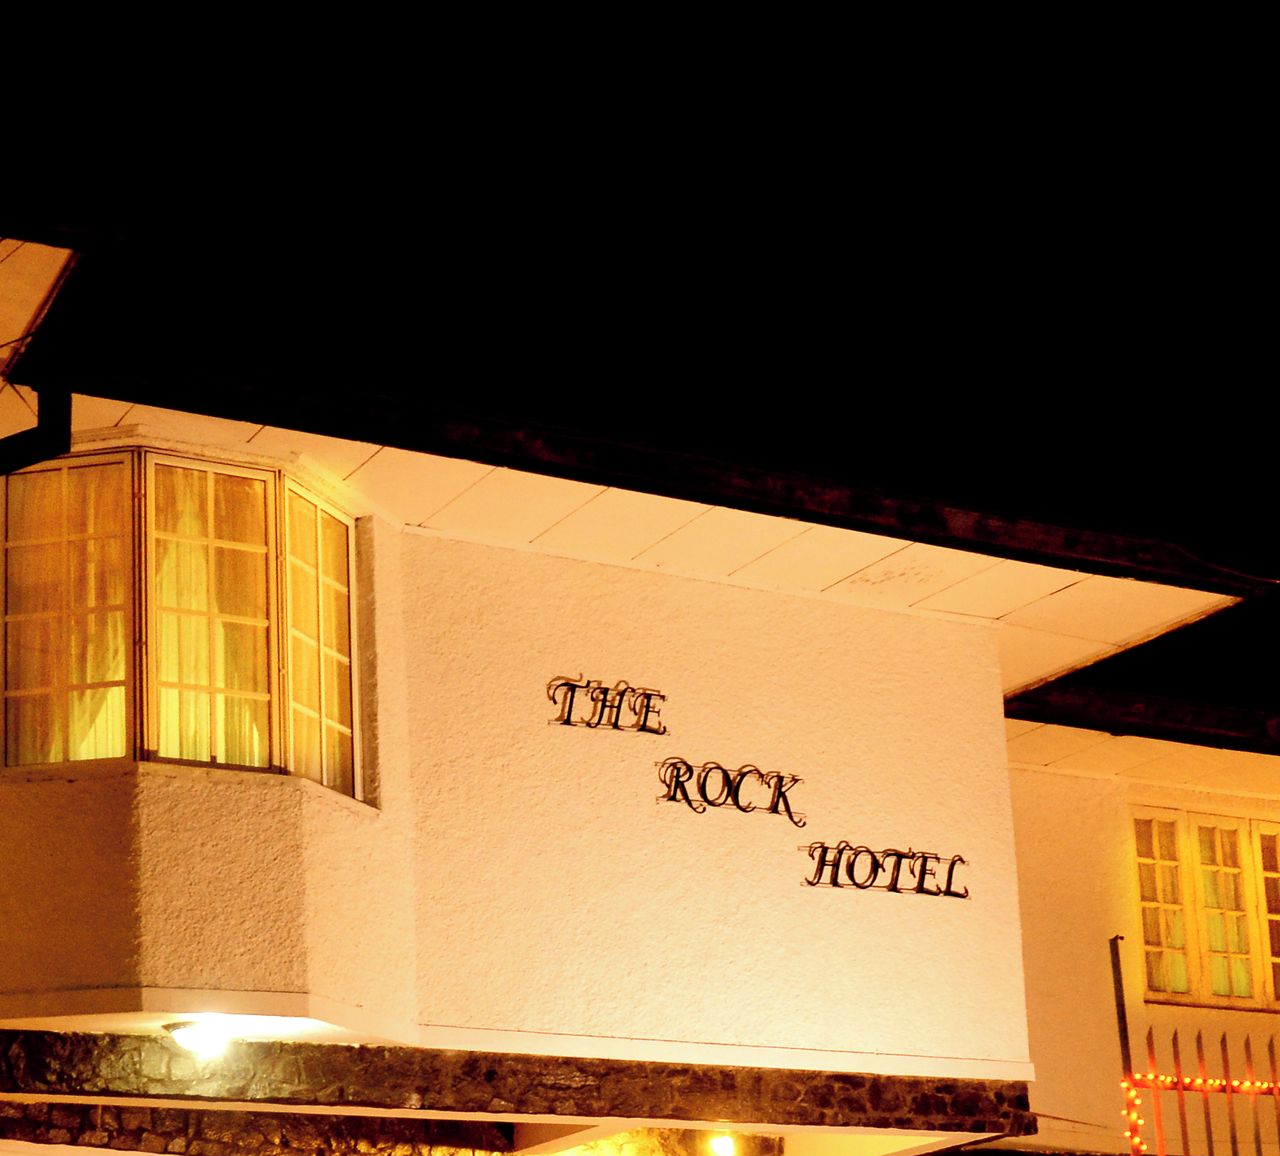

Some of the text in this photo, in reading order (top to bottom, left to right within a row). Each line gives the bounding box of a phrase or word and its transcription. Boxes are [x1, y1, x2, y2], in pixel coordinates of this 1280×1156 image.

[548, 676, 667, 736] THE
[657, 757, 806, 828] ROCK
[801, 841, 969, 899] HOTEL
